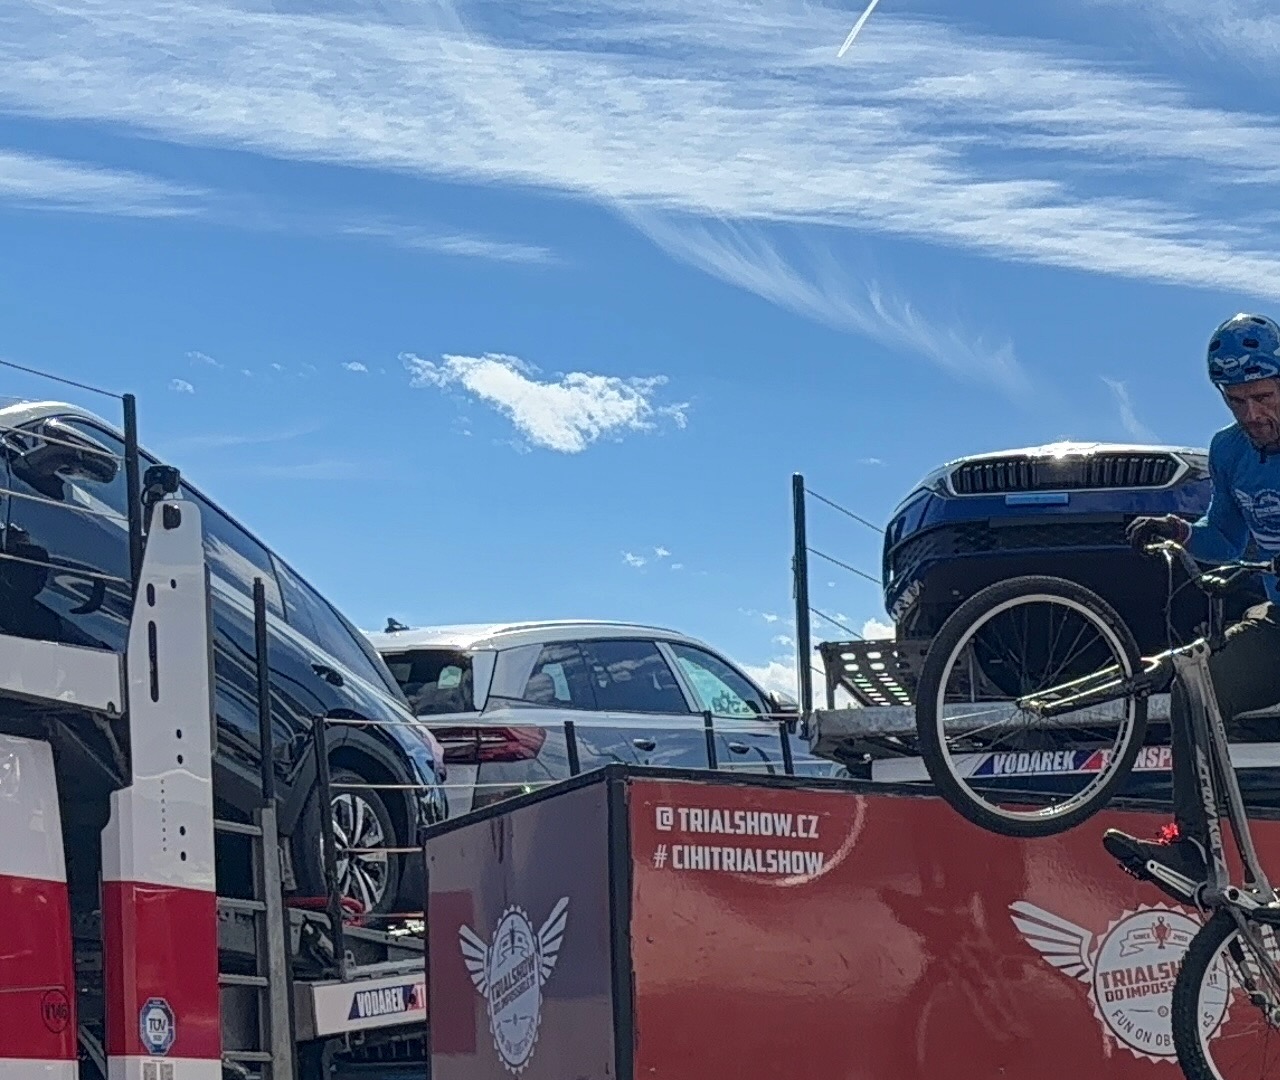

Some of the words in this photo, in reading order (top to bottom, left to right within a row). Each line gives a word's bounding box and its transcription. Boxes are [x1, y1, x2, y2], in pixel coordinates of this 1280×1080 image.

[993, 750, 1076, 775] VODAREK
[678, 807, 819, 839] TRIALSHOW.CZ
[672, 844, 824, 875] CIHITRIALSHOW
[1099, 960, 1182, 989] TRIALSH
[356, 986, 406, 1017] VODAREK
[1112, 1009, 1135, 1033] FUN
[1135, 1028, 1152, 1043] ON
